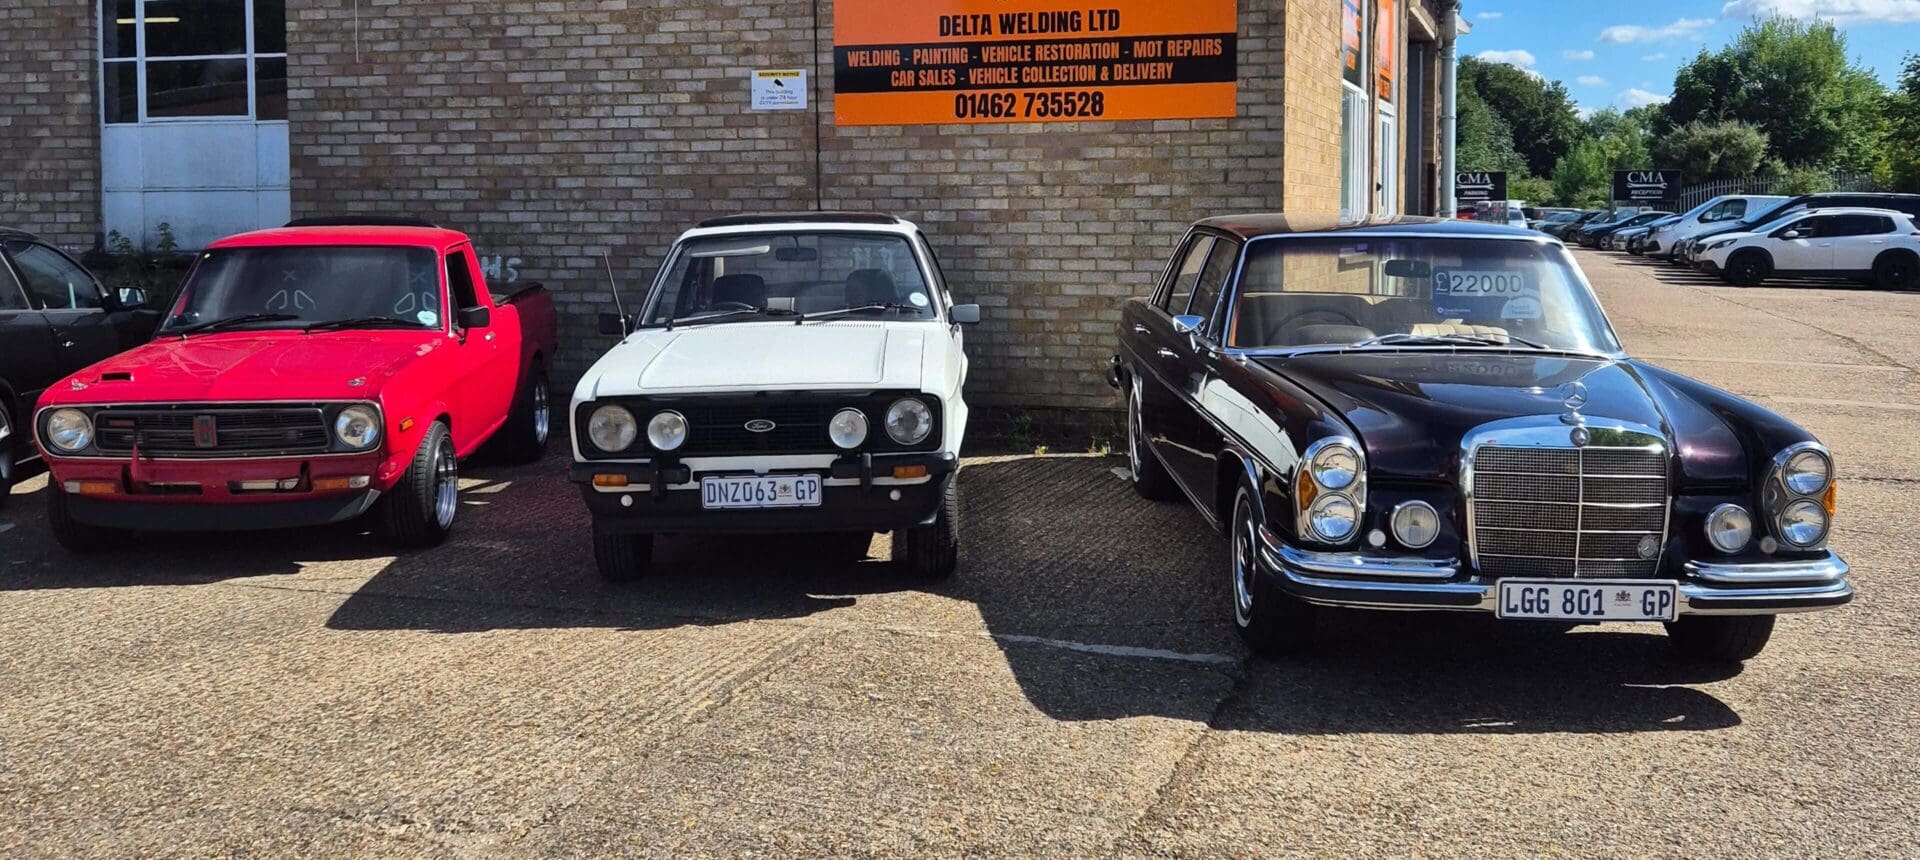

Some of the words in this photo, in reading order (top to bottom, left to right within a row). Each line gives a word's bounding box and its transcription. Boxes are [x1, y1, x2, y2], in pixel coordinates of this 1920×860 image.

[939, 14, 992, 36] DELTA
[999, 10, 1081, 35] WELDING
[1089, 9, 1120, 32] LTD
[848, 50, 900, 67] WELDING
[913, 47, 968, 65] PAINTING
[981, 45, 1031, 63] VEHICLE
[1035, 42, 1120, 61] RESTORATION
[1133, 40, 1163, 58] MOT
[1167, 38, 1223, 57] REPAIRS
[891, 70, 915, 87] CAR
[918, 68, 956, 86] SALES
[969, 67, 1018, 84] VEHICLE
[1022, 64, 1096, 83] COLLECTION
[1100, 65, 1109, 81] &
[1114, 62, 1174, 81] DELIVERY
[955, 93, 1016, 119] 01462
[1023, 91, 1104, 117] 735528
[1456, 173, 1492, 184] CMA
[1626, 171, 1665, 183] CMA
[706, 480, 777, 504] DNZ063
[795, 479, 817, 501] GP
[1506, 587, 1550, 614] LGG
[1562, 588, 1605, 616] 801
[1642, 590, 1671, 617] GP
